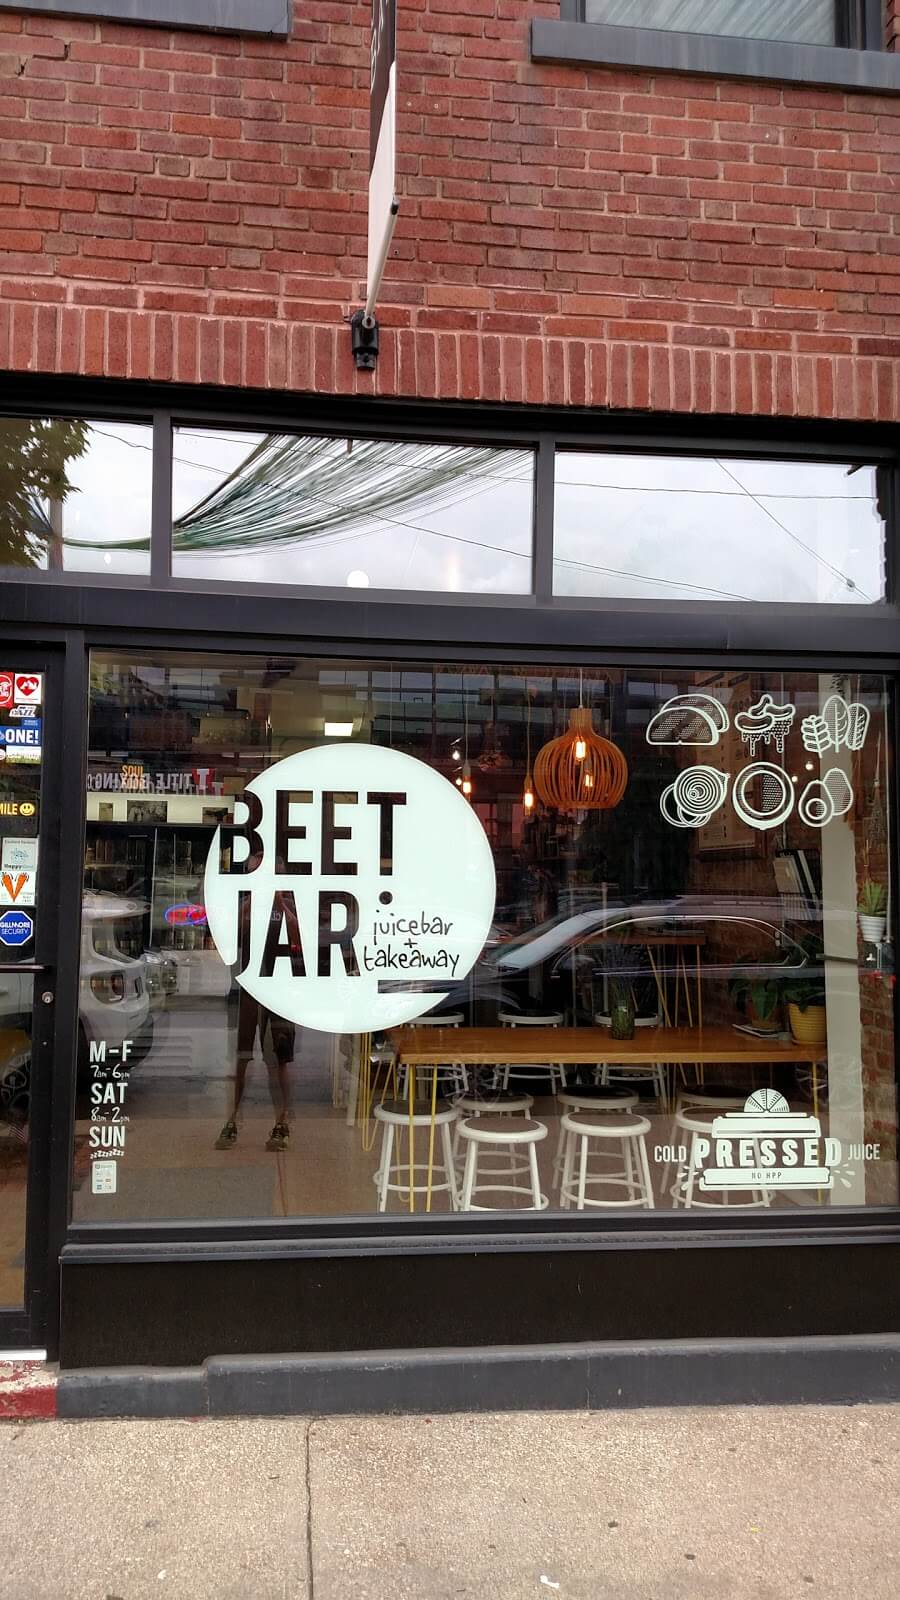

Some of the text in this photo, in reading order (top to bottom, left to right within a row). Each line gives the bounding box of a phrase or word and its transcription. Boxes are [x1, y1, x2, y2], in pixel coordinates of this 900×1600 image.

[5, 728, 39, 744] ONE!
[122, 765, 145, 777] SOUL
[218, 788, 407, 876] BEET
[230, 890, 361, 978] JAR
[373, 909, 454, 946] juicebar
[363, 946, 460, 977] takeaway
[90, 1082, 128, 1105] SAT
[88, 1125, 126, 1148] SUN
[654, 1137, 881, 1168] COLD PRESSED JUICE
[751, 1171, 782, 1180] NO HPP
